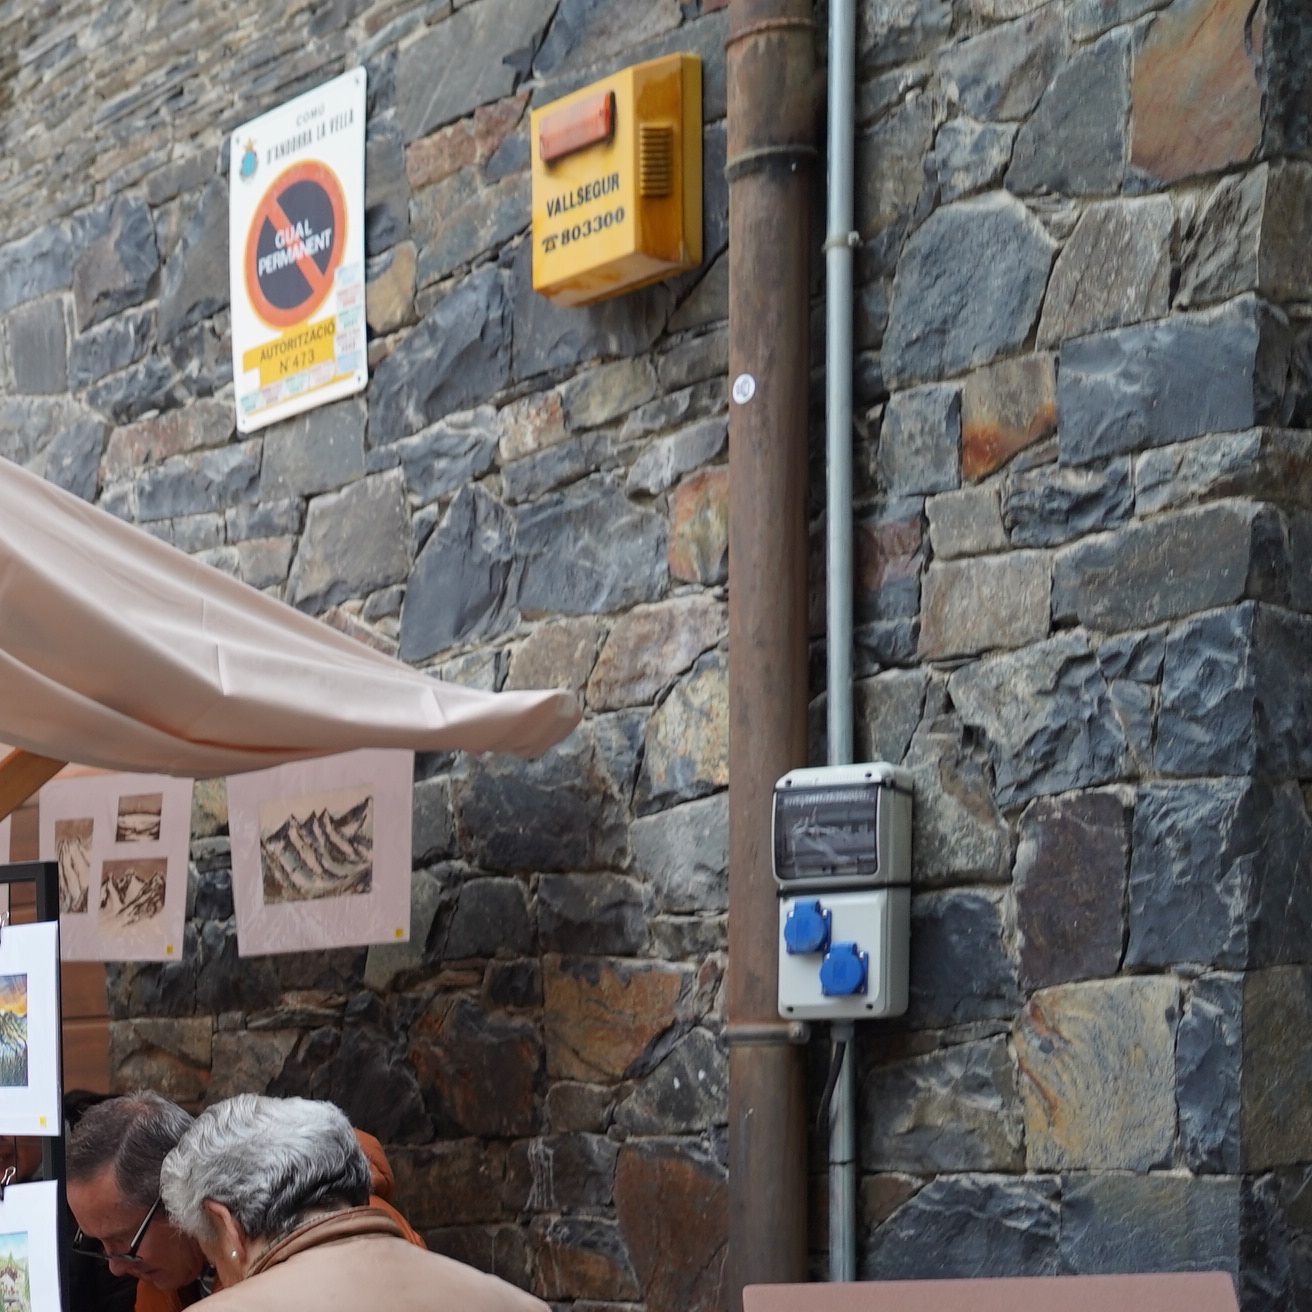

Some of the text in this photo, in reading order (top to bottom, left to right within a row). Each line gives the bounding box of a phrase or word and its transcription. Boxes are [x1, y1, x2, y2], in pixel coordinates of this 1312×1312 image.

[546, 171, 620, 218] VALLSEGUR
[275, 218, 313, 249] GUAL
[561, 206, 625, 246] 803300
[258, 227, 332, 278] PERMANENT
